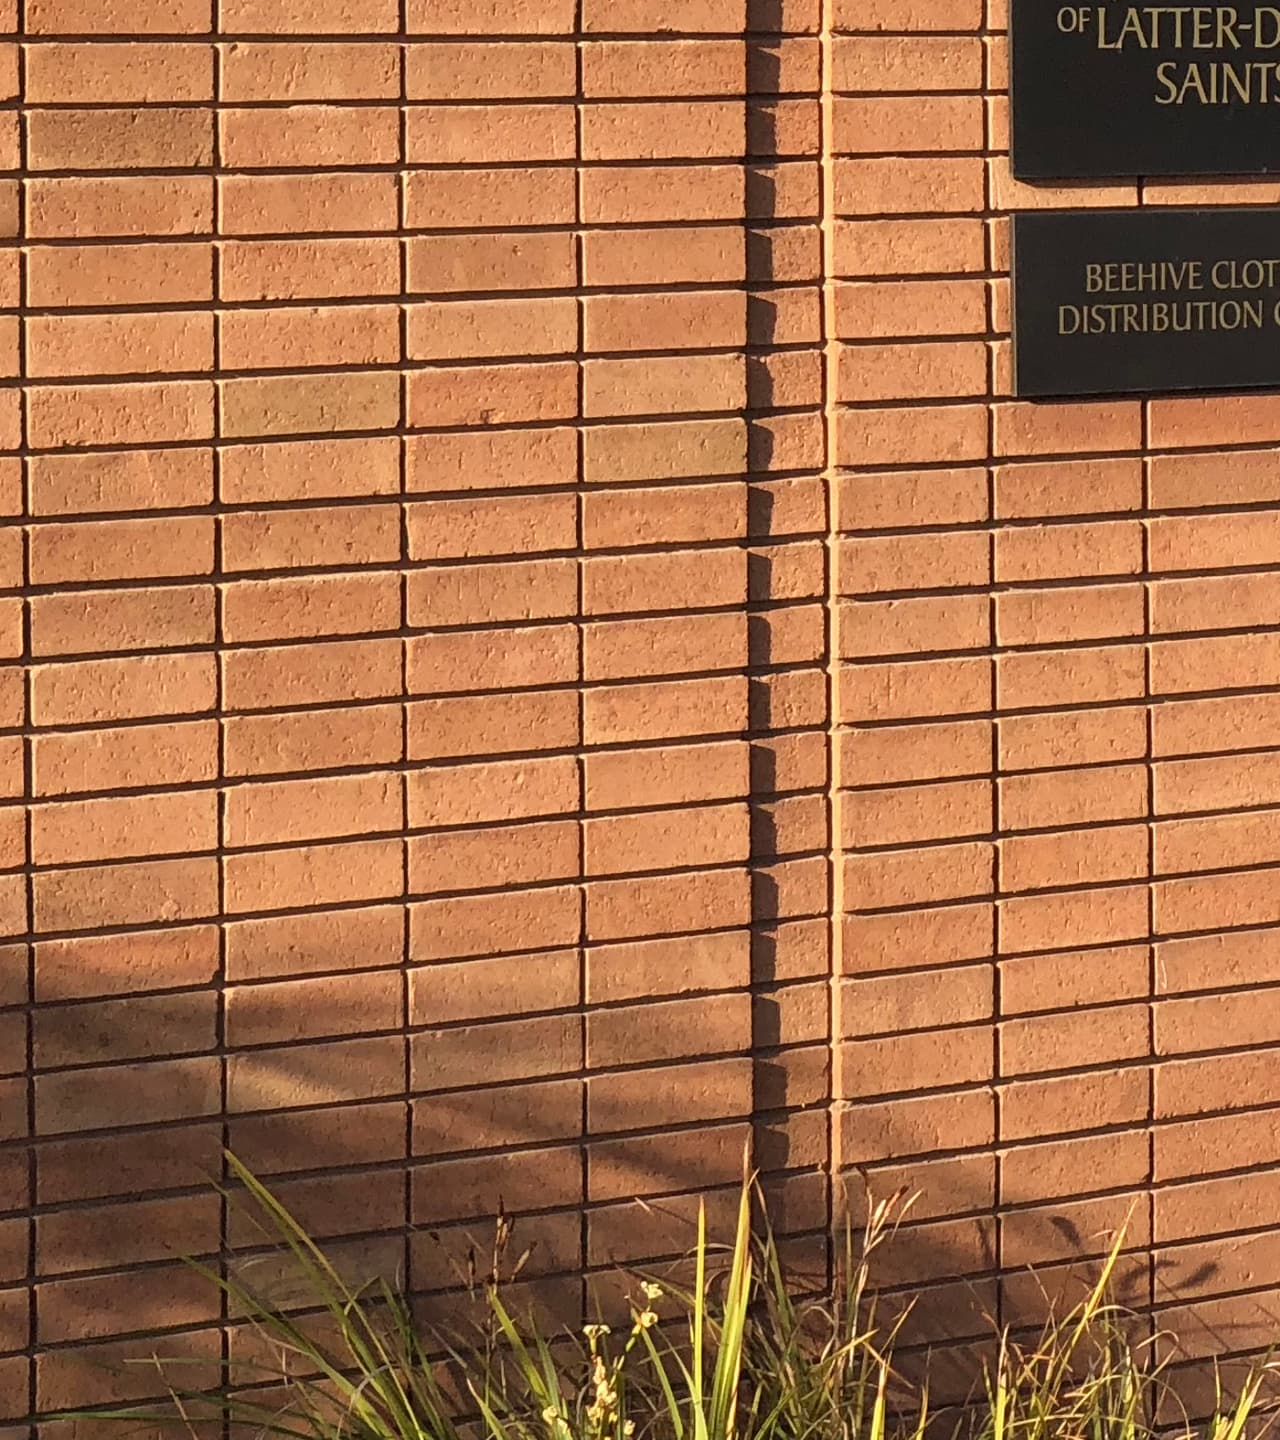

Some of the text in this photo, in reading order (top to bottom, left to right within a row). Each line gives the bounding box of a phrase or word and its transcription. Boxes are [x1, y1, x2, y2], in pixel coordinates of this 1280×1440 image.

[1056, 6, 1092, 32] OF
[1085, 261, 1202, 293] BEEHIVE
[1057, 299, 1264, 335] DISTRIBUTION
